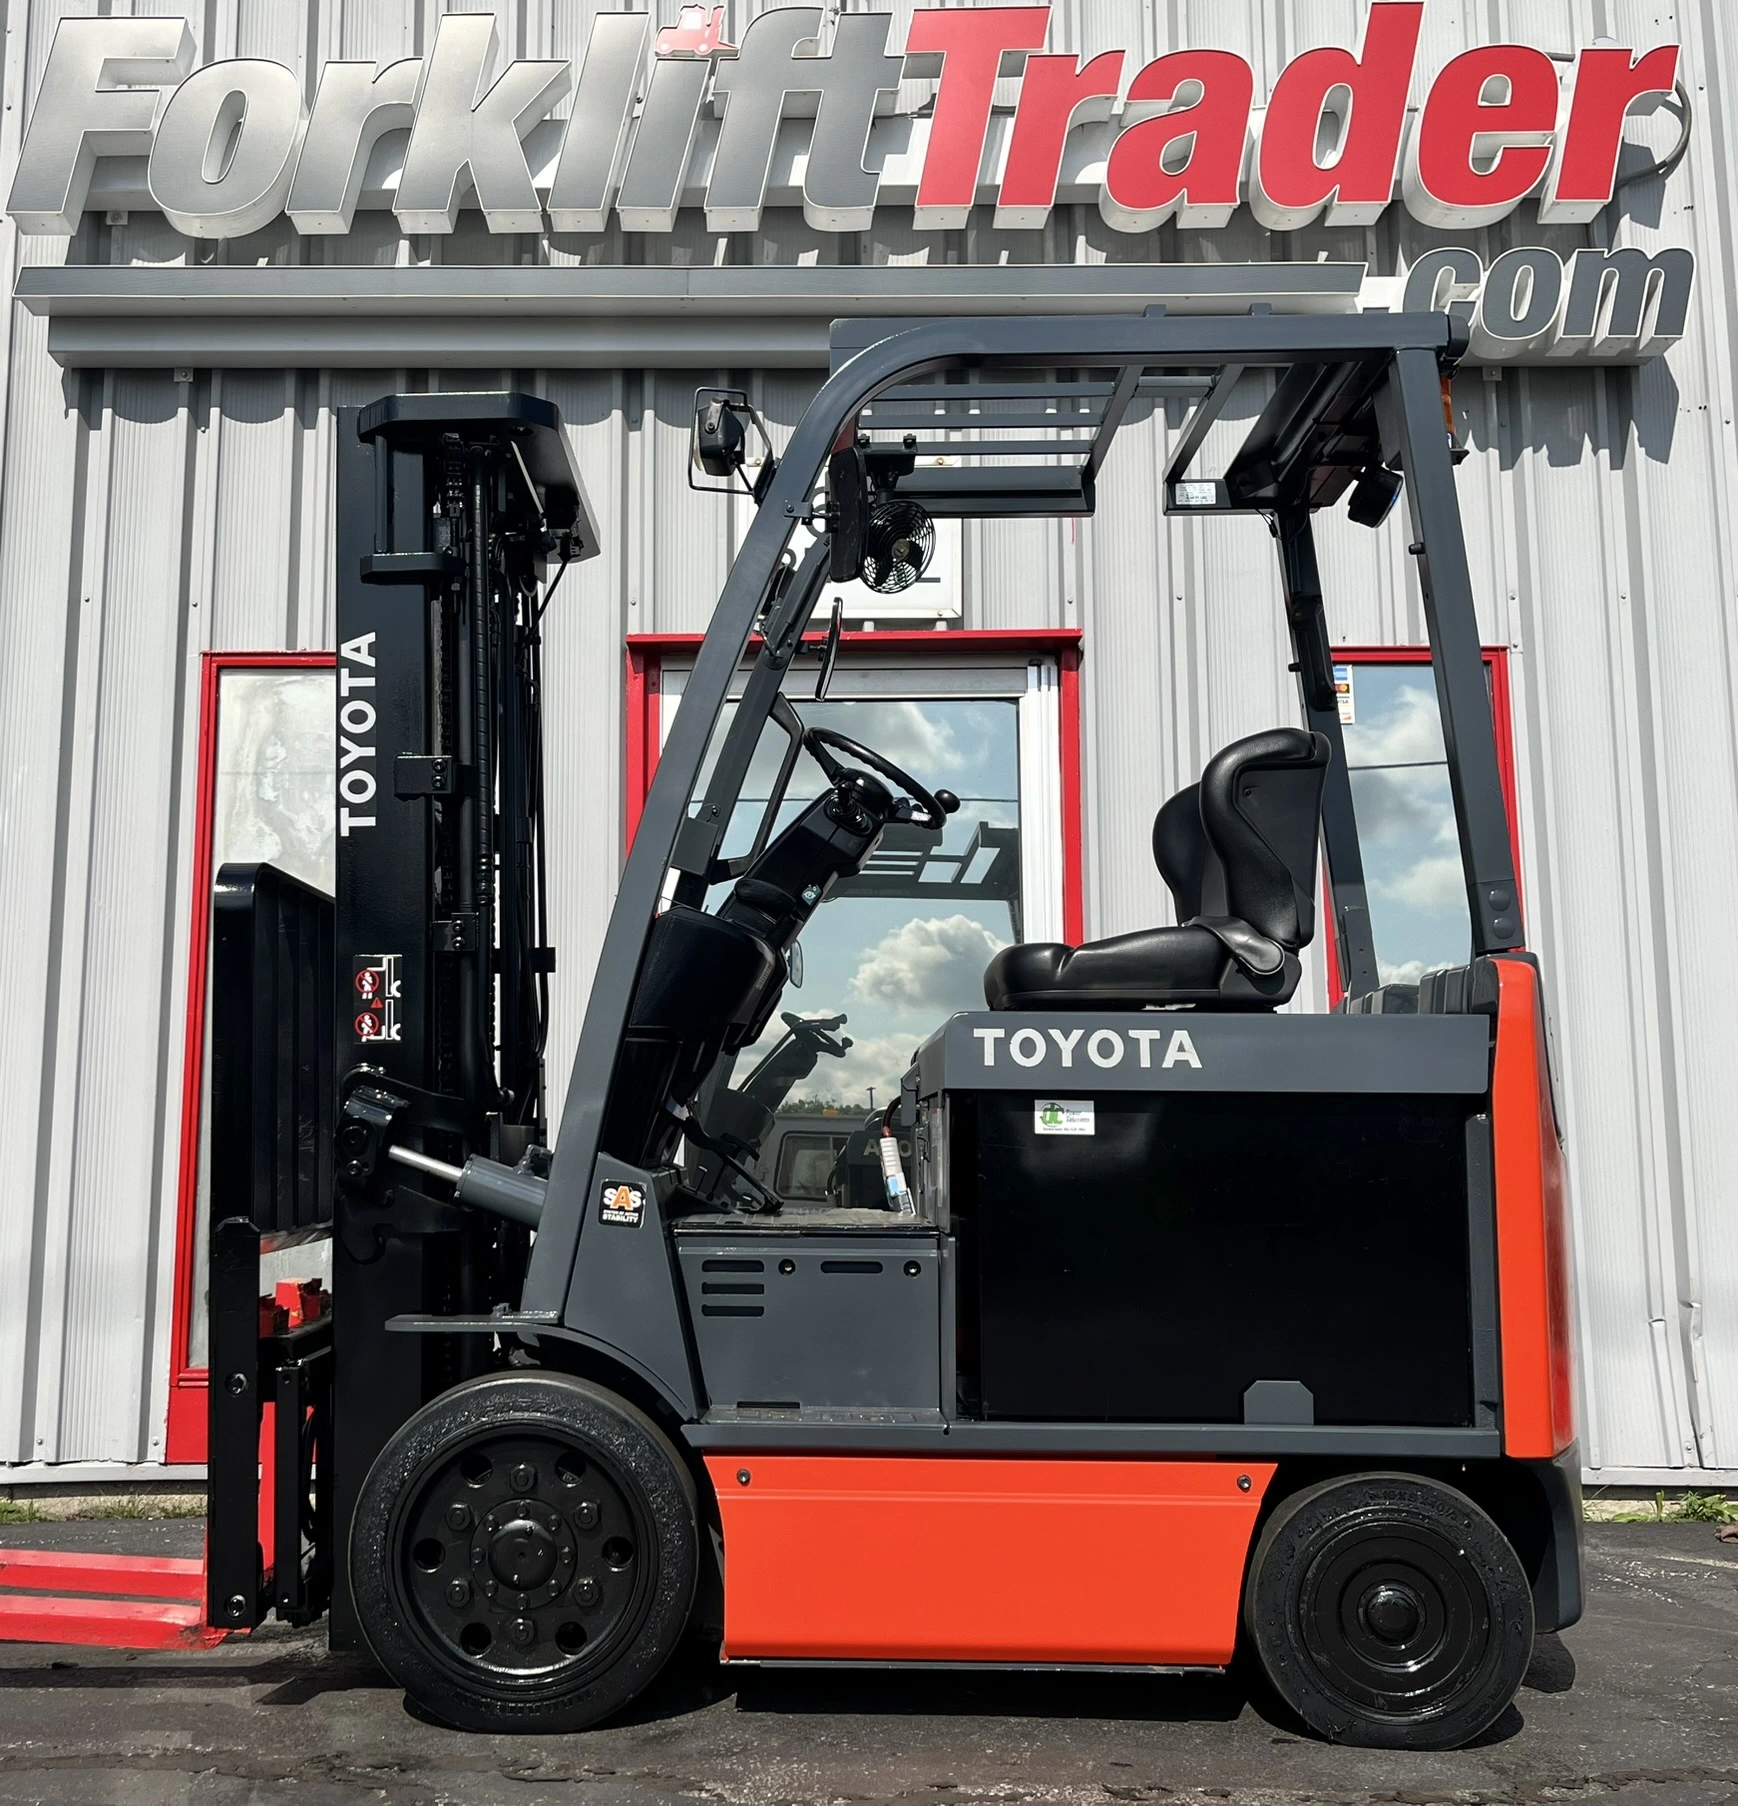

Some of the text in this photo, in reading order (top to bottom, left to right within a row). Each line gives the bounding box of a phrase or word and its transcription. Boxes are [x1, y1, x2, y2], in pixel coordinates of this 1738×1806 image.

[1362, 246, 1697, 340] com
[340, 631, 377, 837] TOYOTA
[973, 1028, 1203, 1068] TOYOTA
[603, 1185, 642, 1210] SAS
[602, 1213, 639, 1223] STABILITY
